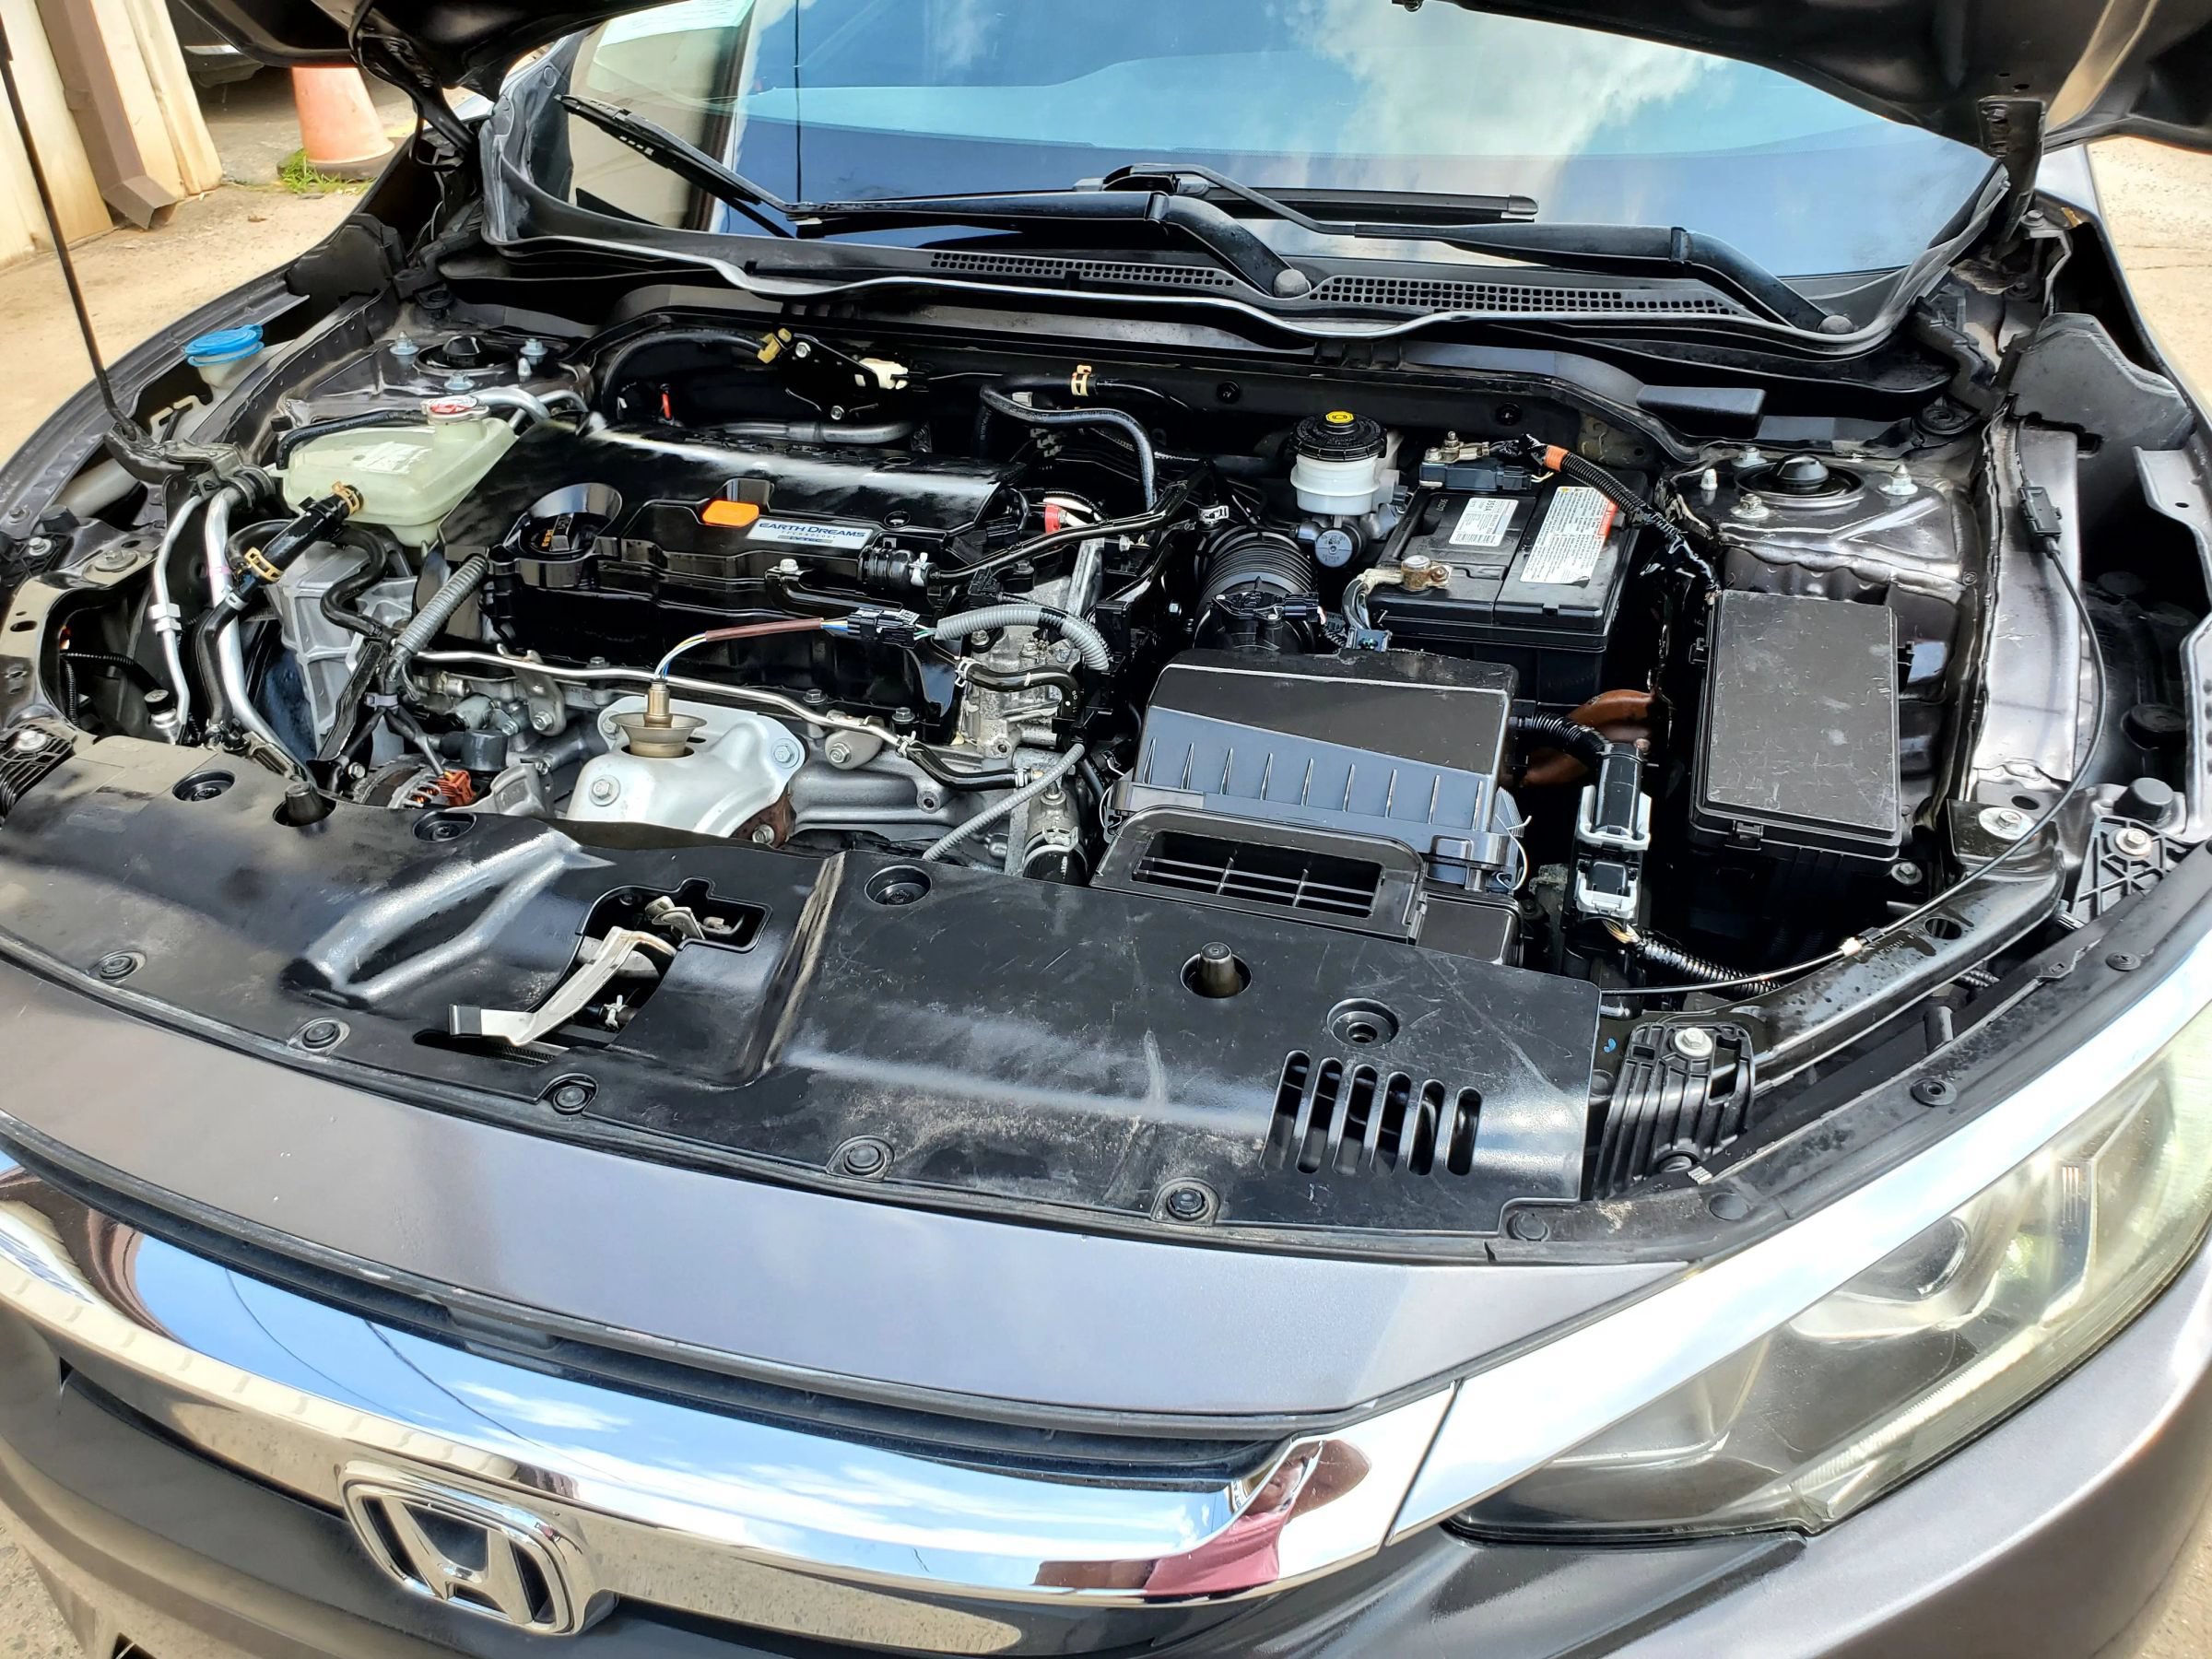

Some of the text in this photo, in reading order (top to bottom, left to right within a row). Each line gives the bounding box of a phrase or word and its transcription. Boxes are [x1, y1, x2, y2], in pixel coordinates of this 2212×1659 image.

[759, 523, 866, 537] EARTH DREAMS
[781, 531, 837, 539] TECHNOLOGY
